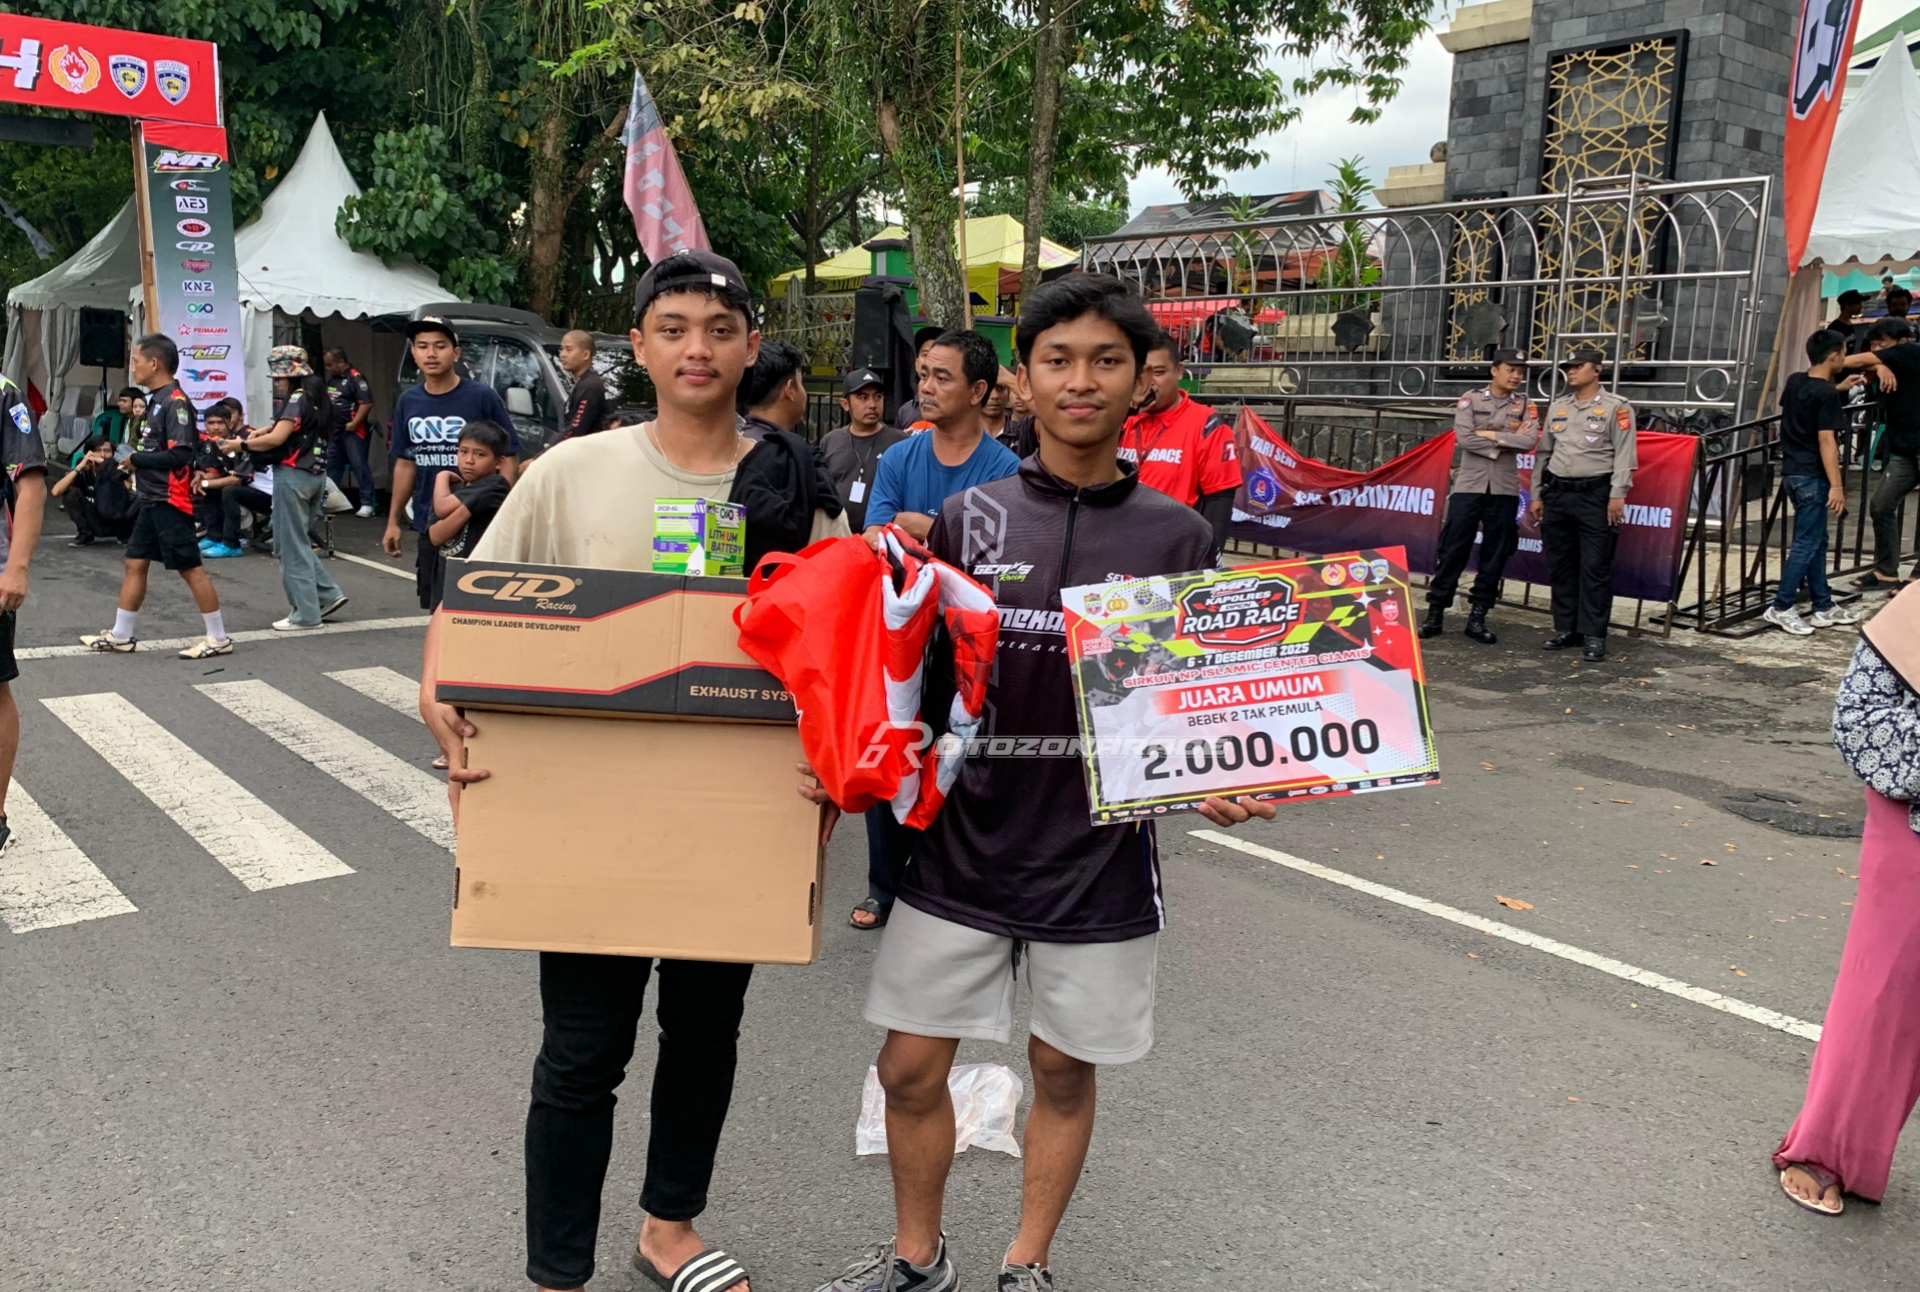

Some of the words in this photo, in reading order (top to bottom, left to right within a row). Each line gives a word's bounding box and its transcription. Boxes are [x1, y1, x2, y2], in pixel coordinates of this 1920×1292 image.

[157, 152, 219, 168] MR
[178, 198, 206, 209] AES
[184, 281, 212, 292] KNZ
[409, 418, 466, 441] KNZ
[1249, 435, 1273, 458] TARI
[711, 541, 743, 555] BATTERY
[535, 598, 577, 614] Racing
[1205, 590, 1272, 606] KAPOLRES
[1225, 602, 1251, 610] OPEN
[451, 617, 492, 627] CHAMPION
[494, 620, 524, 629] LEADER
[525, 622, 581, 632] DEVELOPMENT
[1182, 611, 1241, 634] ROAD
[1243, 603, 1300, 626] RACE
[1186, 657, 1194, 668] 6
[1206, 654, 1213, 665] 7
[1214, 646, 1277, 663] DESEMBER
[1279, 642, 1310, 655] 2025
[1123, 673, 1176, 689] SIRKUIT
[1178, 669, 1200, 681] NP
[1202, 660, 1261, 678] ISLAMIC
[1263, 654, 1319, 670] CENTER
[1319, 648, 1372, 664] CIAMIS
[689, 685, 758, 700] EXHAUST
[761, 689, 789, 702] SYS
[1178, 684, 1247, 710] JUARA
[1250, 674, 1324, 699] UMUM
[1187, 712, 1229, 727] BEBEK
[1230, 710, 1239, 722] 2
[1241, 706, 1267, 720] TAK
[1268, 700, 1323, 717] PEMULA
[1141, 717, 1380, 781] 2.000.000
